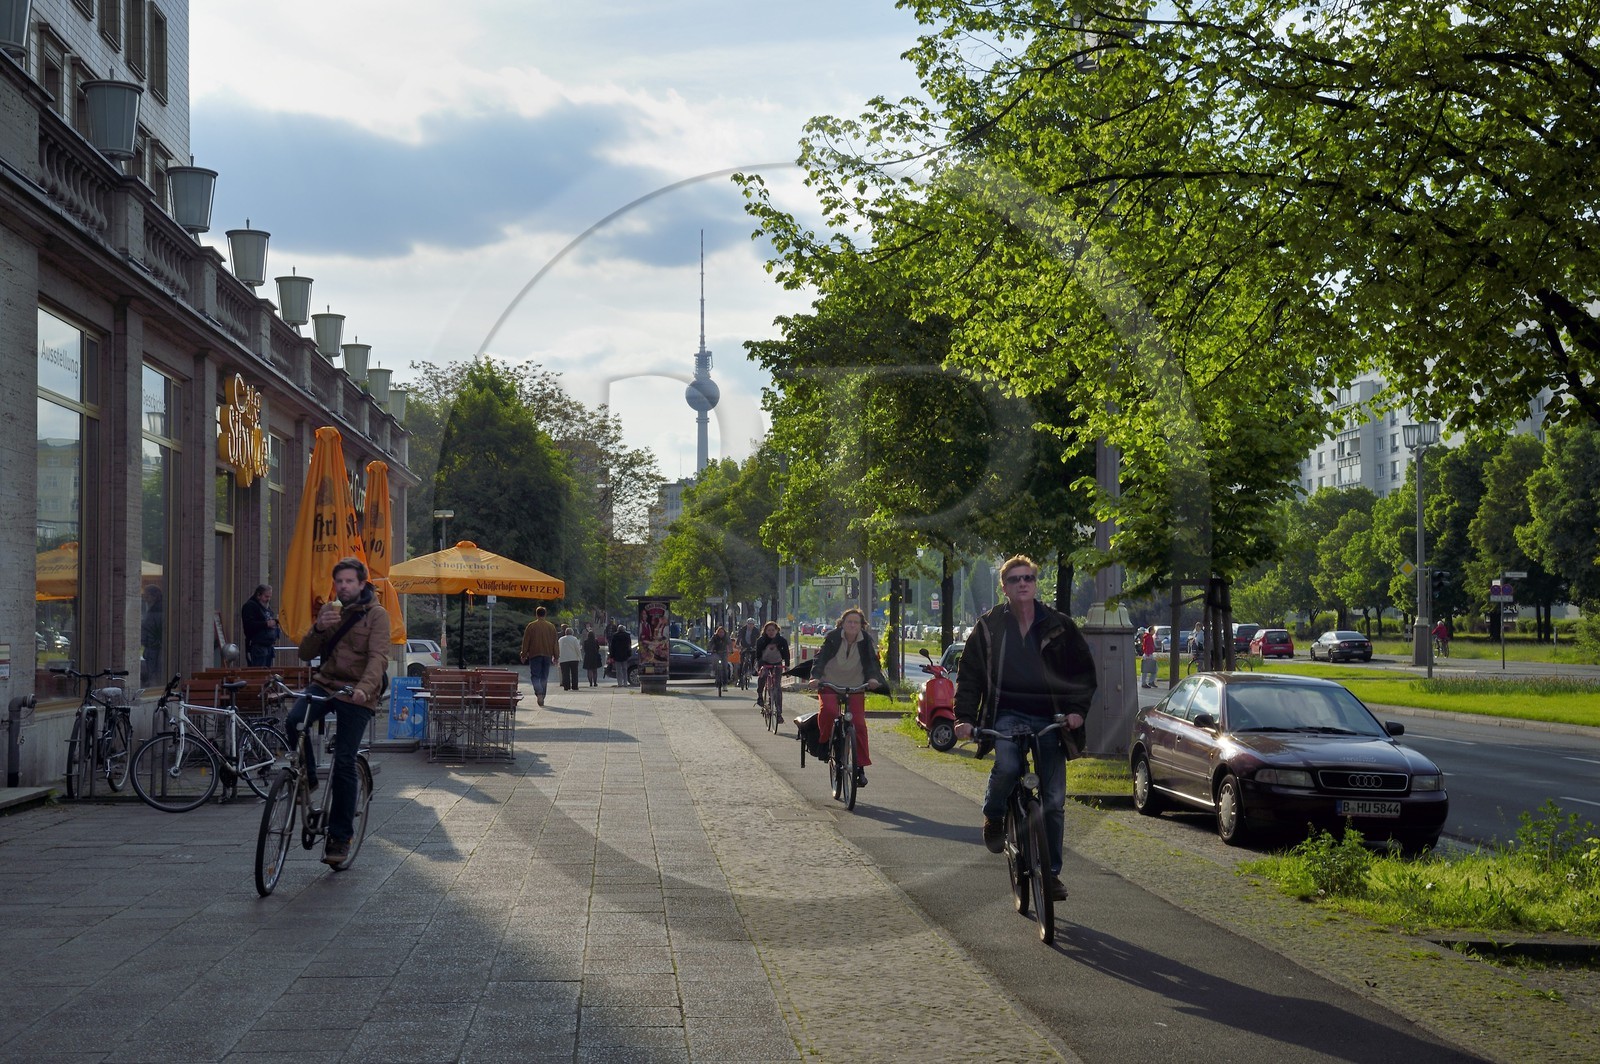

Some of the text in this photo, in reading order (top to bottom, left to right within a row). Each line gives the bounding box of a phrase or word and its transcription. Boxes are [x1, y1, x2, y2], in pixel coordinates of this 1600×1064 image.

[40, 339, 79, 379] Ausstellung
[519, 584, 560, 594] WEIZEN
[1343, 802, 1400, 815] B HU 5844
